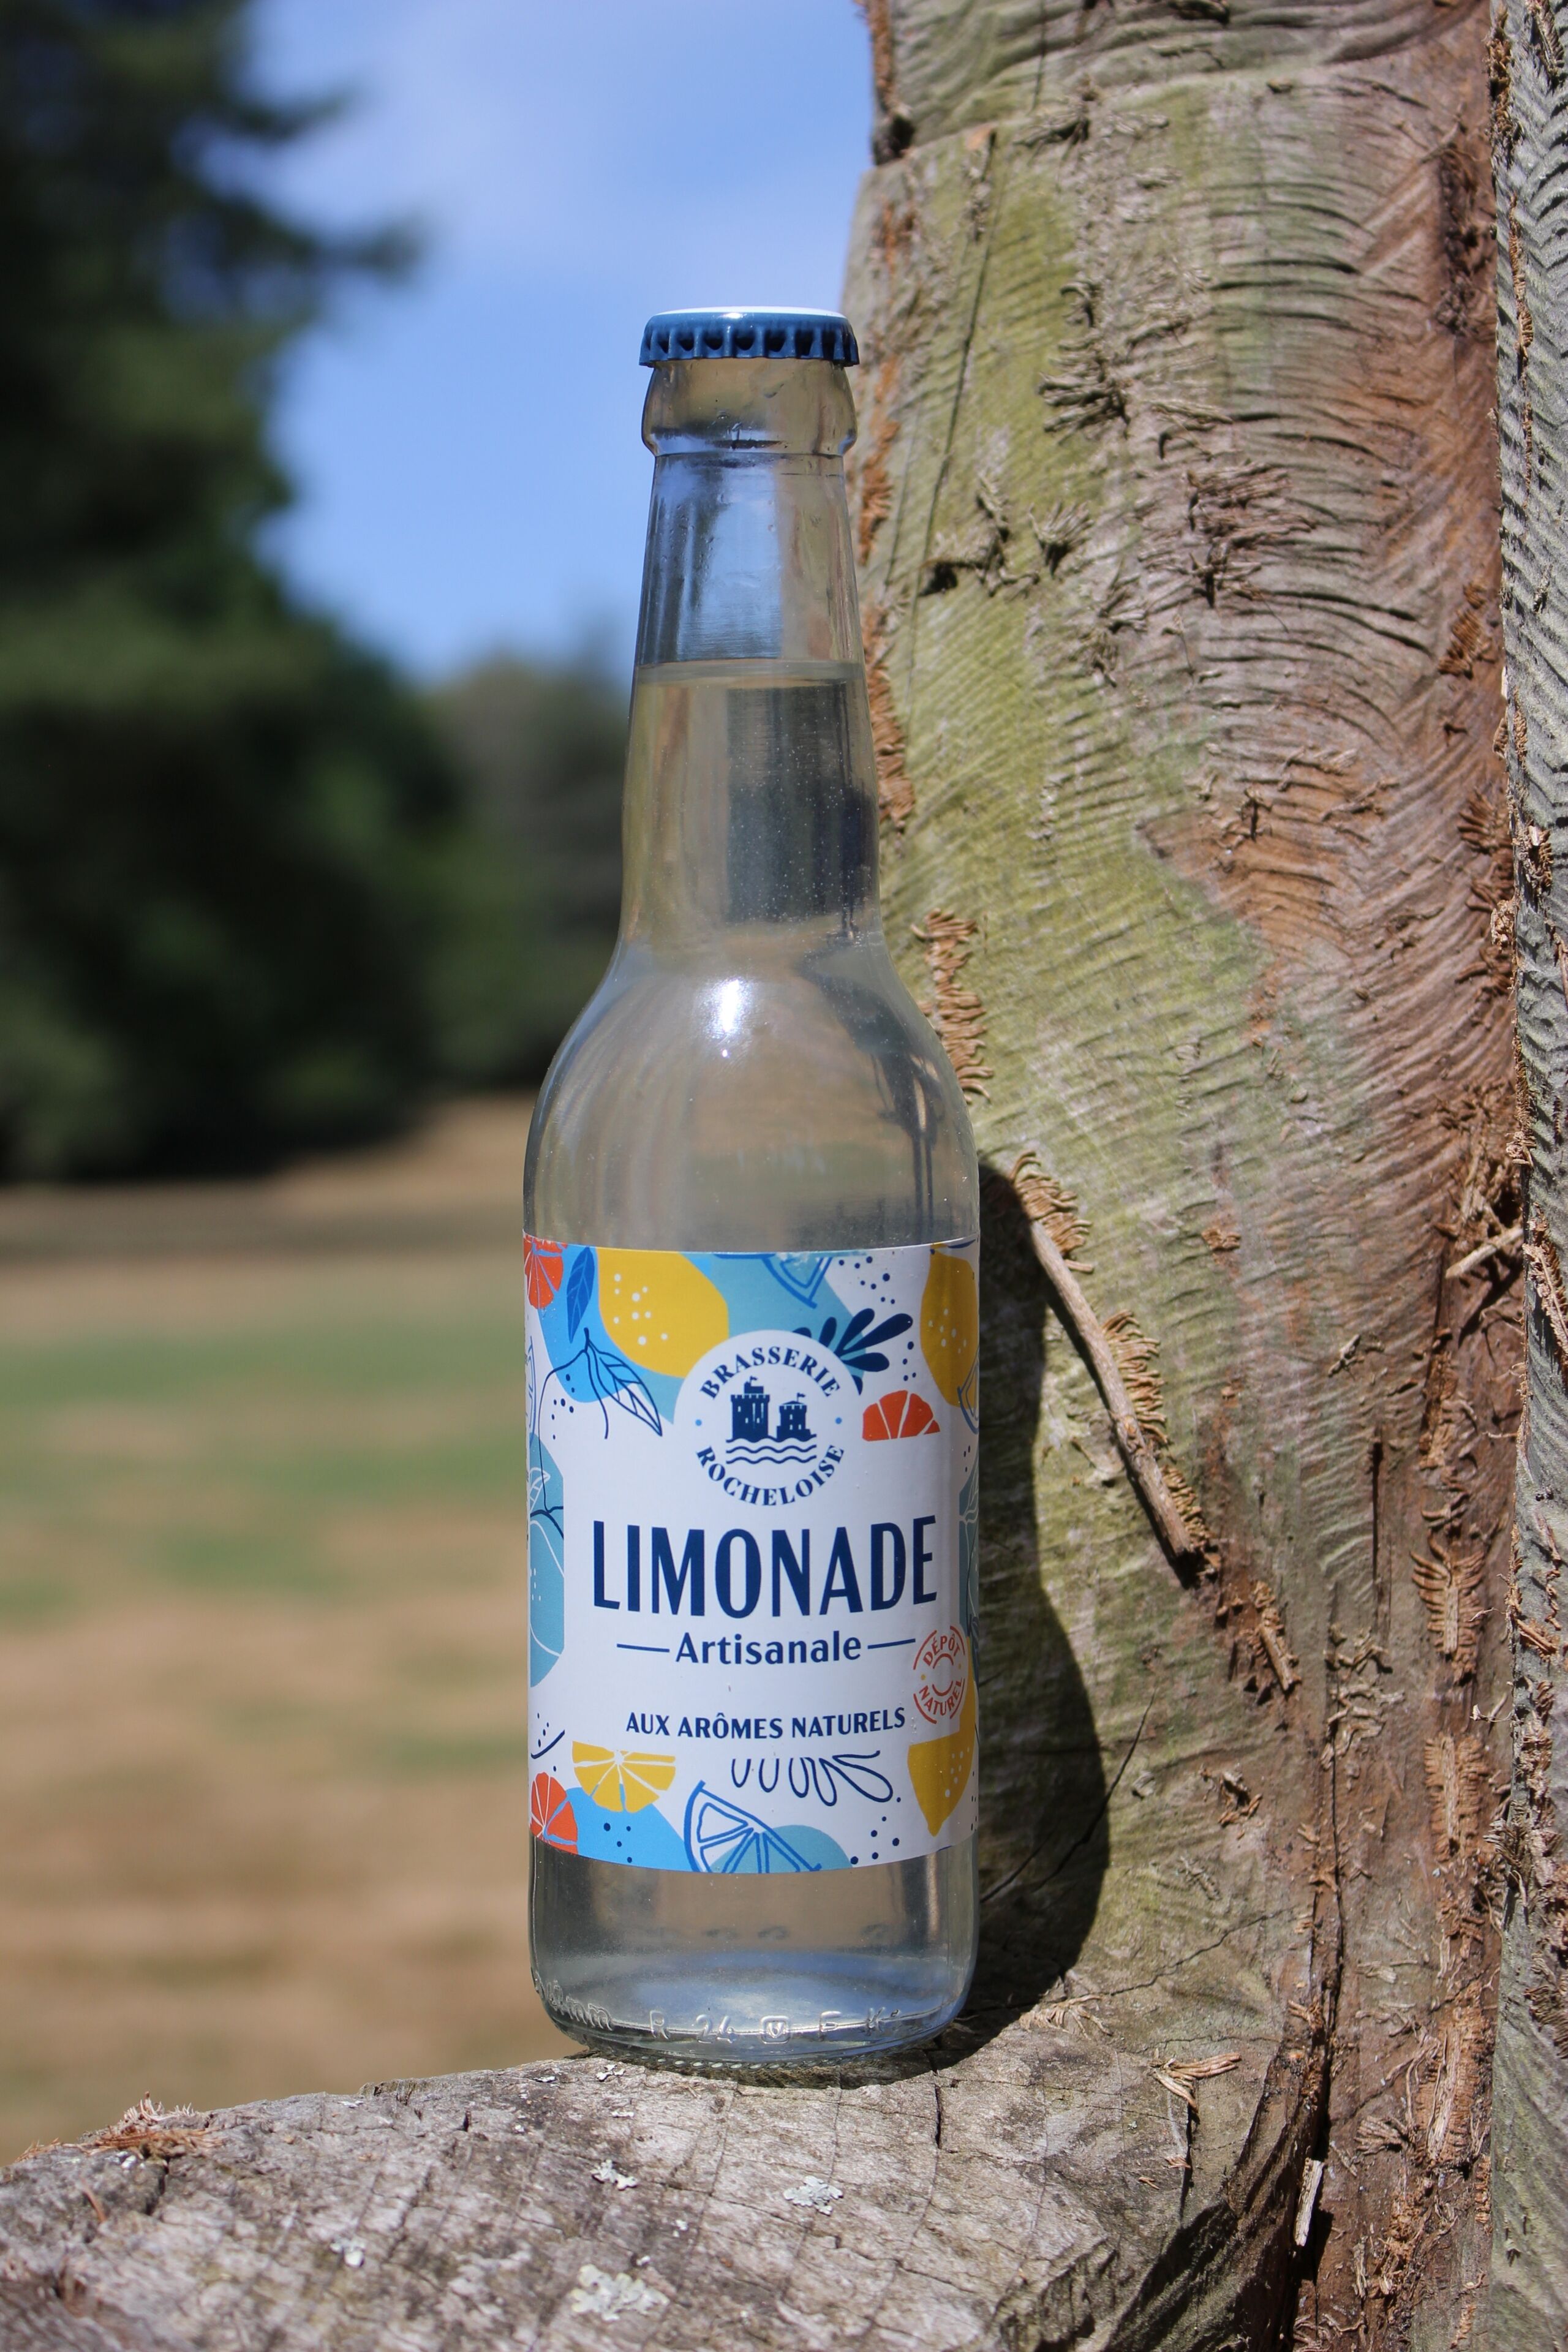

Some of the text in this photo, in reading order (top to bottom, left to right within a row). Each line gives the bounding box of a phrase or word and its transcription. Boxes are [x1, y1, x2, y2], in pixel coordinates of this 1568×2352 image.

[699, 1346, 840, 1400] BRASSERIE
[696, 1444, 844, 1506] ROCHELOISE
[593, 1515, 937, 1619] LIMONADE
[675, 1630, 861, 1665] Artisanale
[922, 1634, 961, 1667] DÉPÔT
[919, 1677, 963, 1716] NATUREL
[625, 1706, 906, 1740] AUX ARÔMES NATURELS
